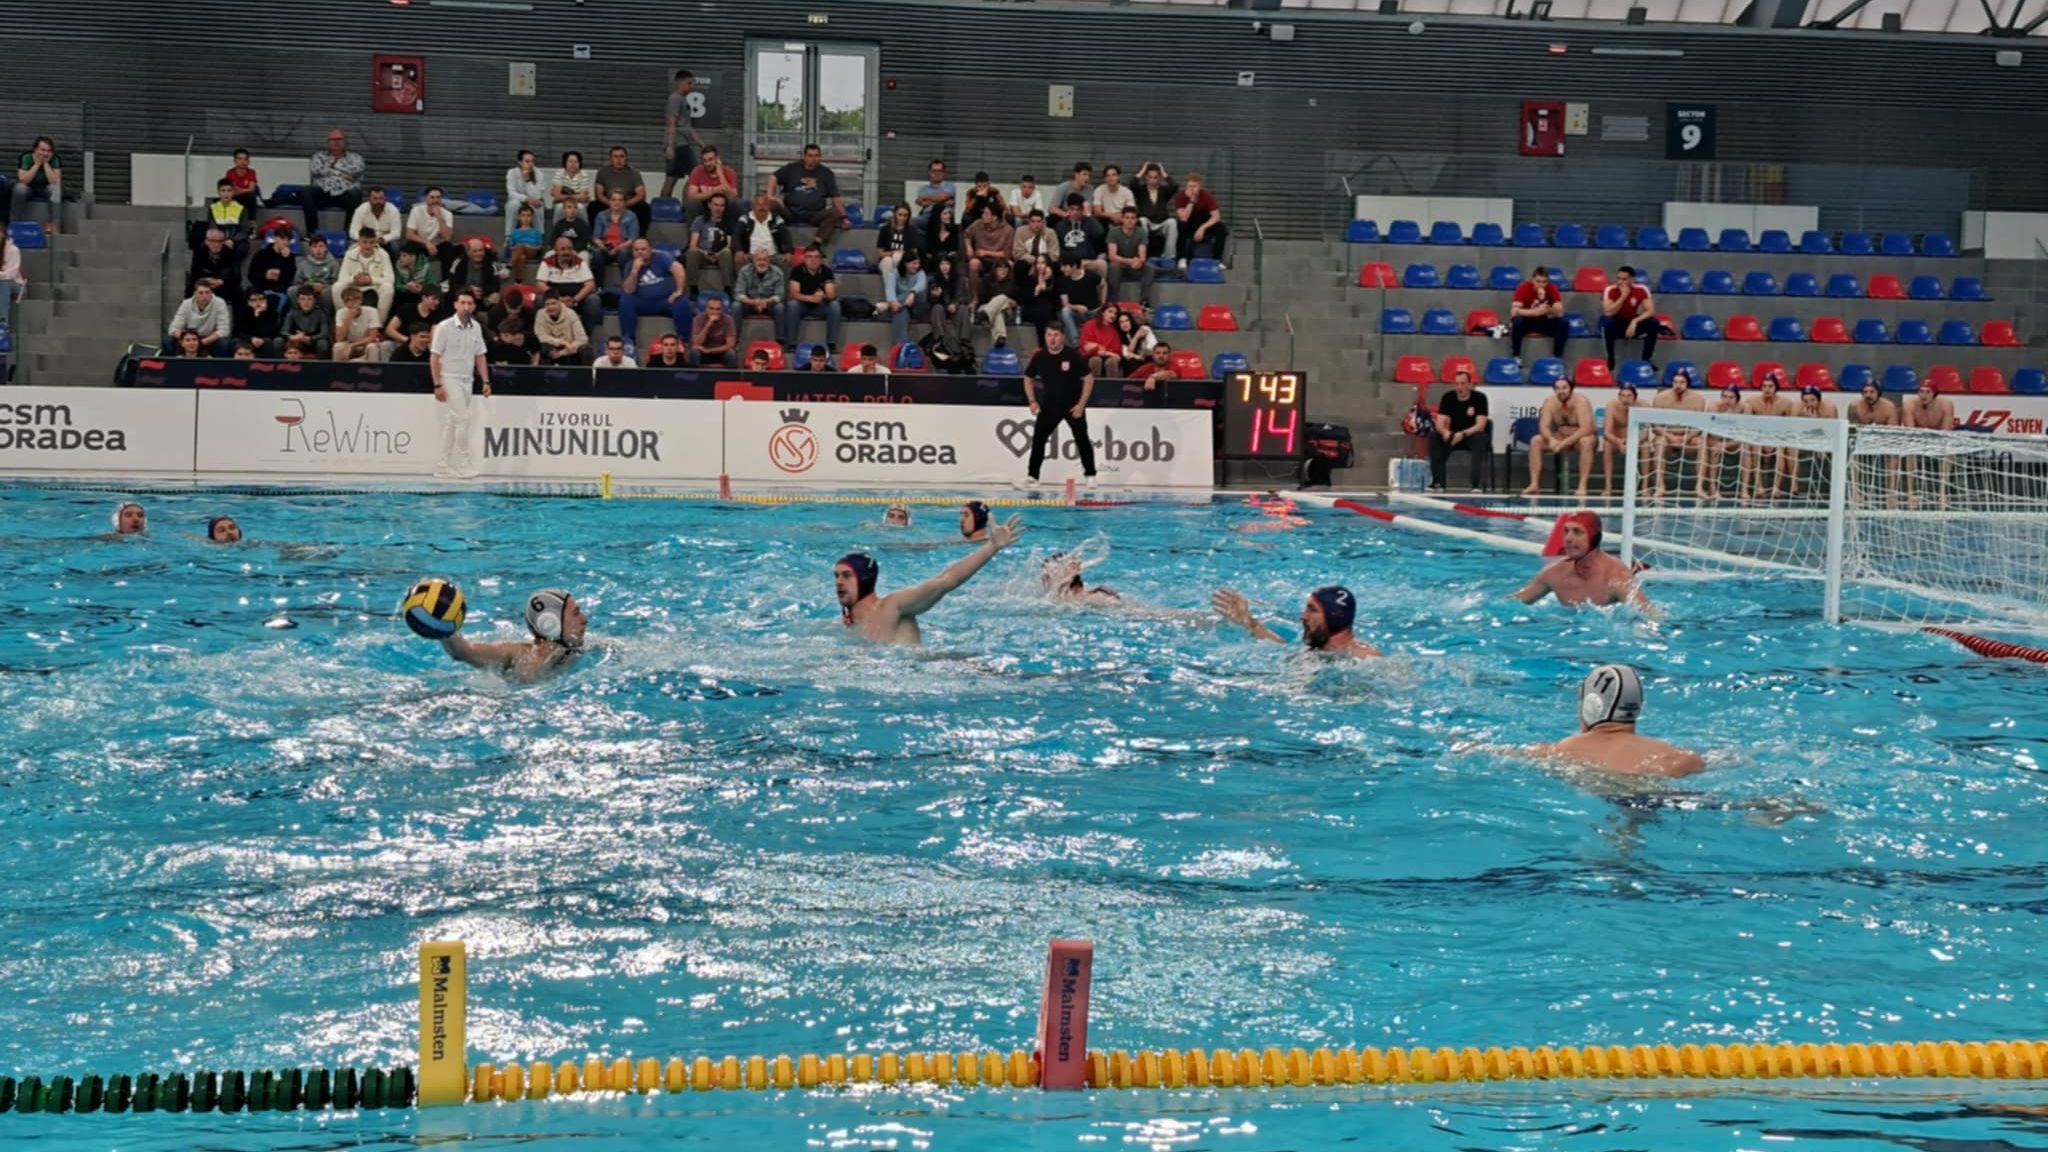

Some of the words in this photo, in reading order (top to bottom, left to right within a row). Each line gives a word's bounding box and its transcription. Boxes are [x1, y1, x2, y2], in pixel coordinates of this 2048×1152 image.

[686, 91, 706, 118] 8
[1681, 124, 1702, 150] 9
[275, 398, 412, 454] ReWine
[540, 412, 613, 427] IZVORUL
[1251, 408, 1297, 453] 14
[2007, 418, 2044, 433] SEVEN
[484, 427, 661, 461] MINUNILOR
[531, 596, 545, 612] 6
[1336, 590, 1348, 606] 2
[1593, 671, 1615, 694] 11
[432, 977, 449, 1061] Malmsten
[1058, 978, 1077, 1063] Malmsten
